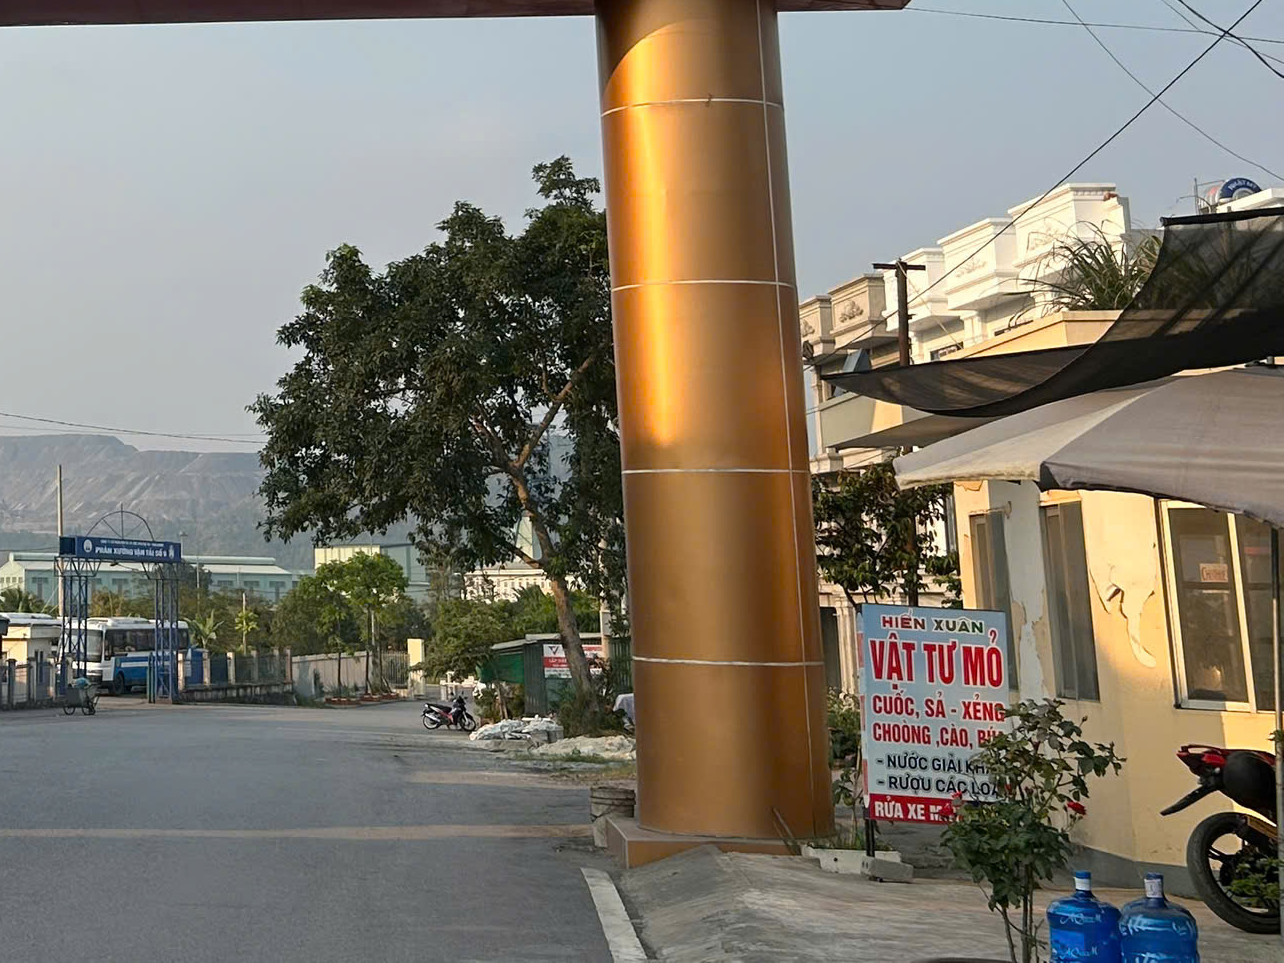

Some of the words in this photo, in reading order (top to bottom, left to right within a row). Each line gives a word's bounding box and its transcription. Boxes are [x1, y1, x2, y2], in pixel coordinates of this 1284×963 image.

[934, 617, 984, 633] XUÂN
[870, 632, 916, 690] VẬT
[923, 641, 957, 685] TƯ
[962, 630, 1003, 688] MỎ
[872, 690, 919, 718] CUỐC,
[924, 691, 947, 718] SẢ
[873, 720, 931, 745] CHOÒNG
[887, 752, 928, 770] NƯỚC
[874, 796, 904, 819] RỬA
[908, 804, 926, 821] XE
